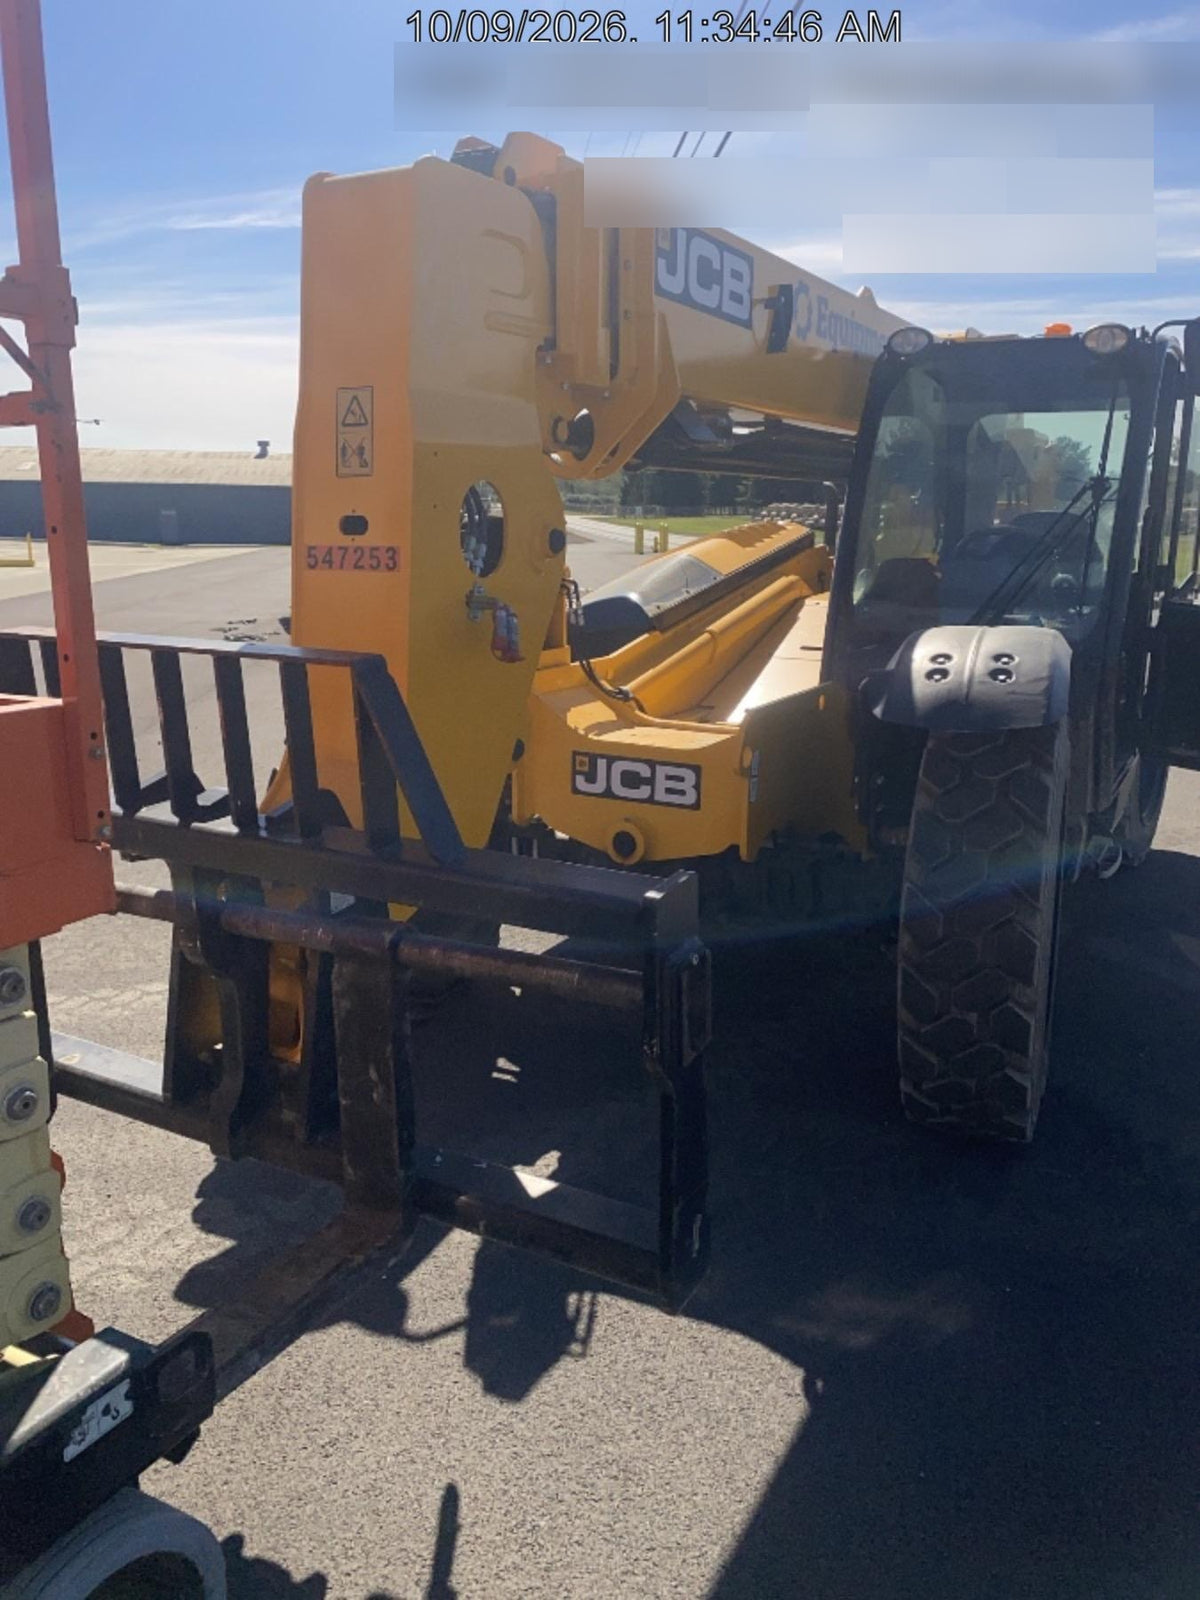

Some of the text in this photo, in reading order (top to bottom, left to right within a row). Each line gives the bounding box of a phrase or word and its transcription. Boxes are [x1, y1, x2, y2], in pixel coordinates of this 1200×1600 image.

[657, 228, 751, 321] JCB
[306, 545, 399, 571] 547253
[575, 758, 698, 806] JCB
